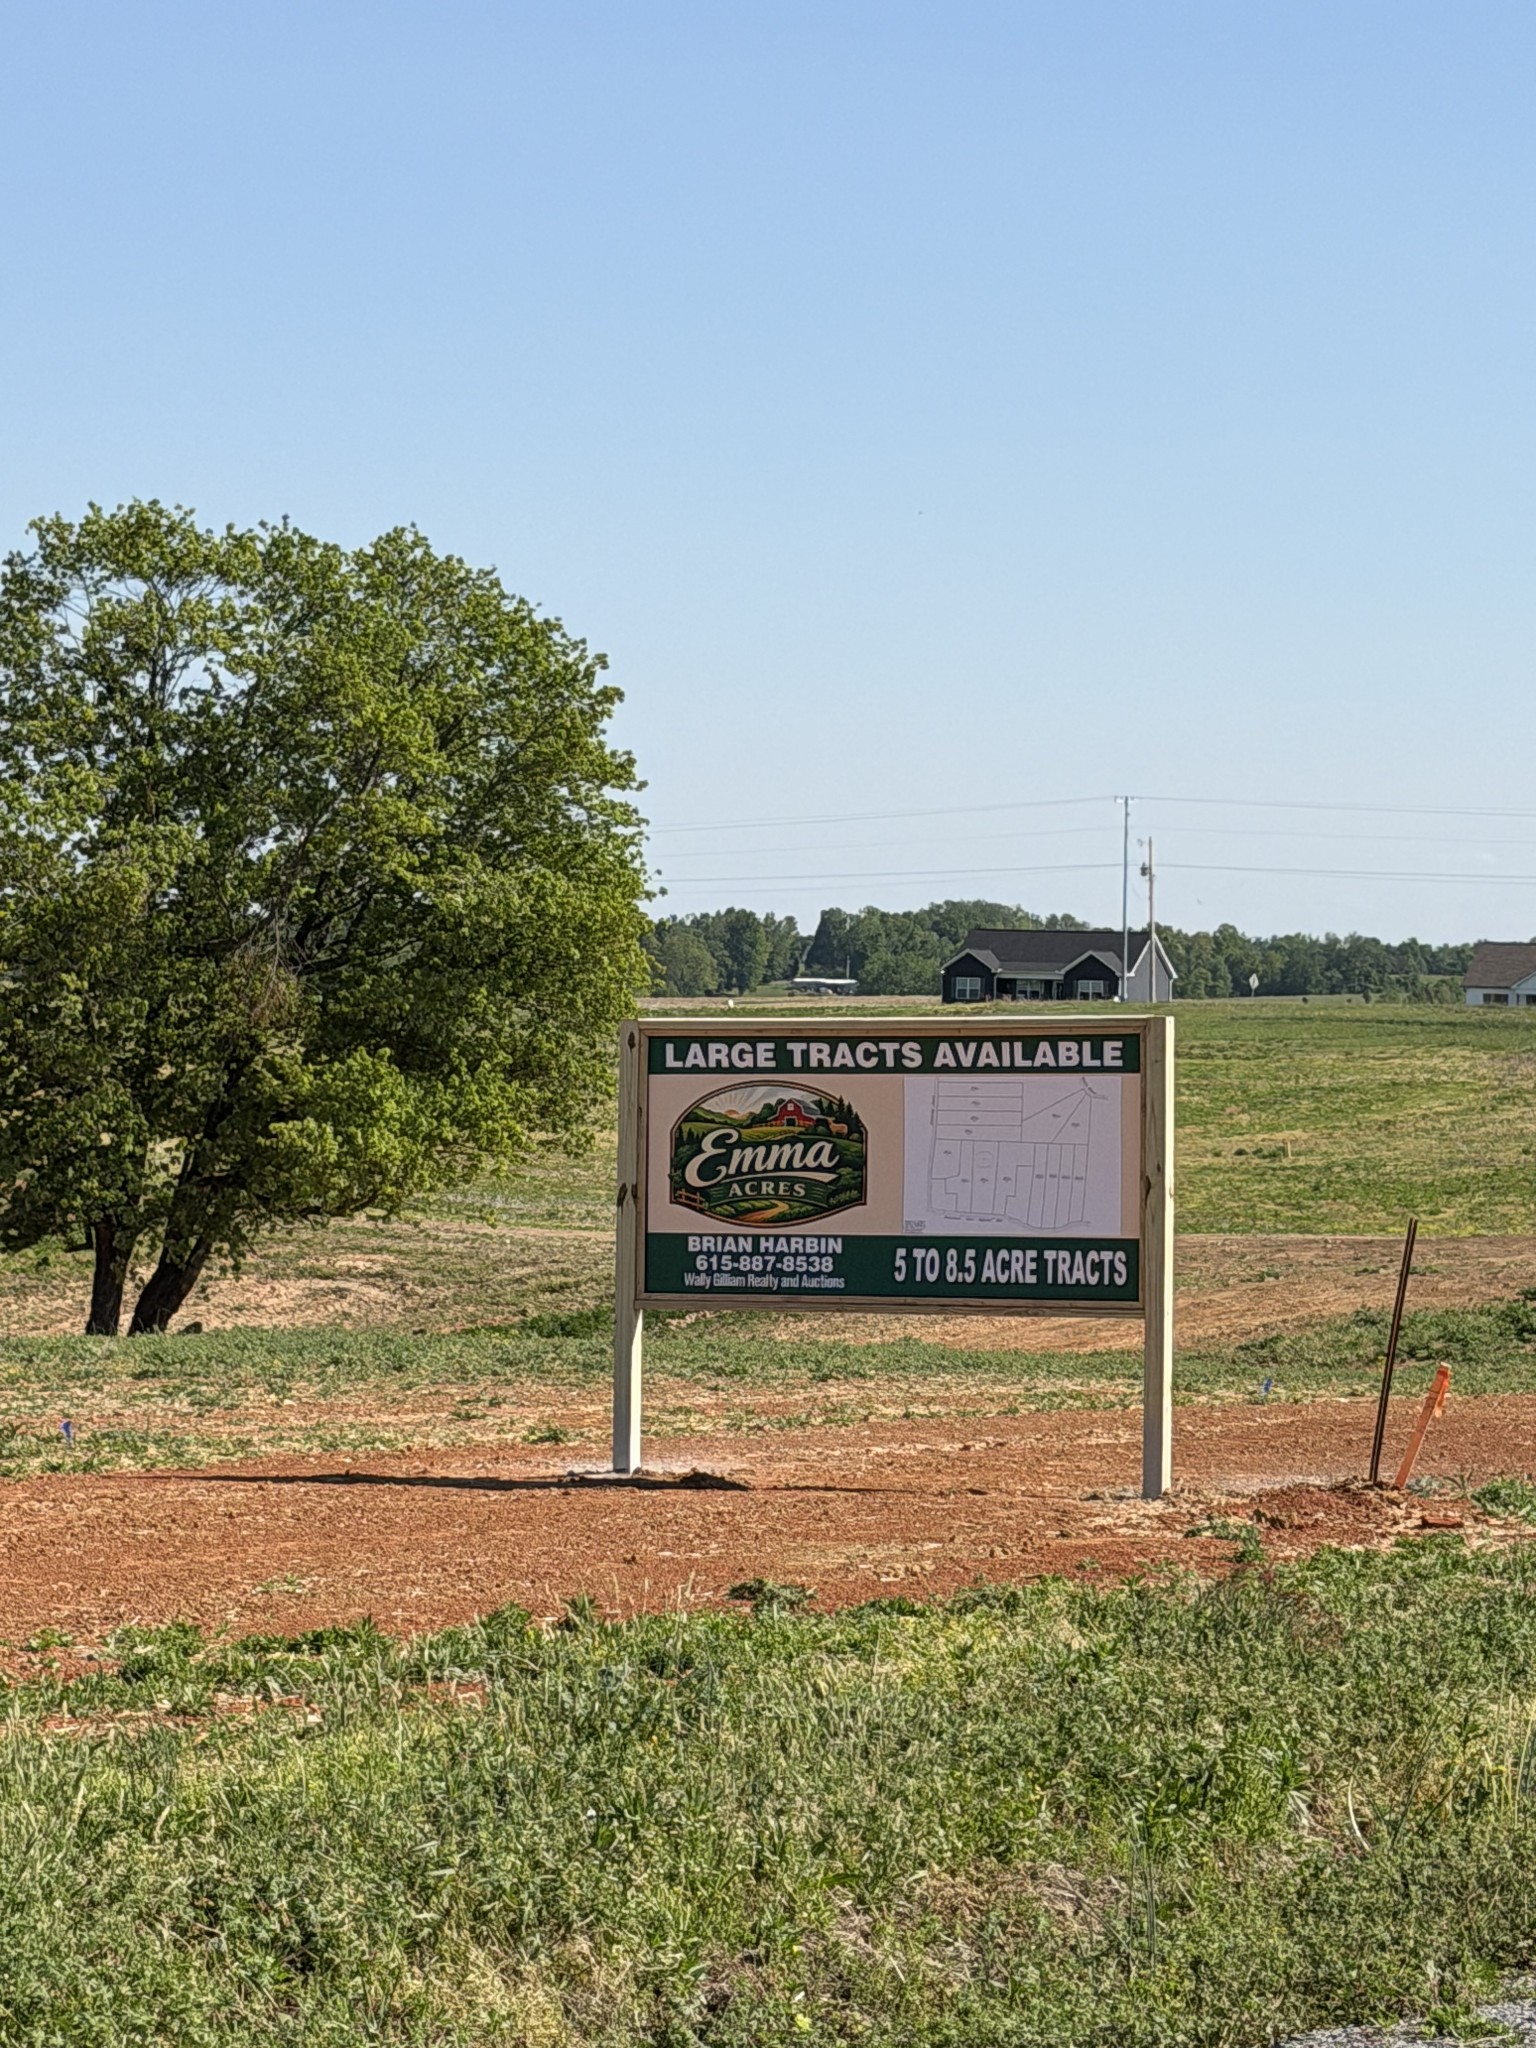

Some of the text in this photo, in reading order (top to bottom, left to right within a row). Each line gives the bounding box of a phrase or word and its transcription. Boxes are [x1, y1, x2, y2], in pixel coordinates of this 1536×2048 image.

[664, 1040, 1124, 1069] LARGE TRACTS AVAILABLE
[684, 1128, 840, 1188] Emma
[728, 1181, 806, 1198] ACRES
[687, 1235, 843, 1254] BRIAN HARBIN
[695, 1254, 834, 1273] 615-887-8538
[893, 1247, 1128, 1286] 5 TO 8.5 ACRE TRACTS
[684, 1272, 711, 1290] Wally
[747, 1273, 779, 1291] Realty
[780, 1274, 800, 1288] and
[801, 1274, 845, 1289] Auctions
